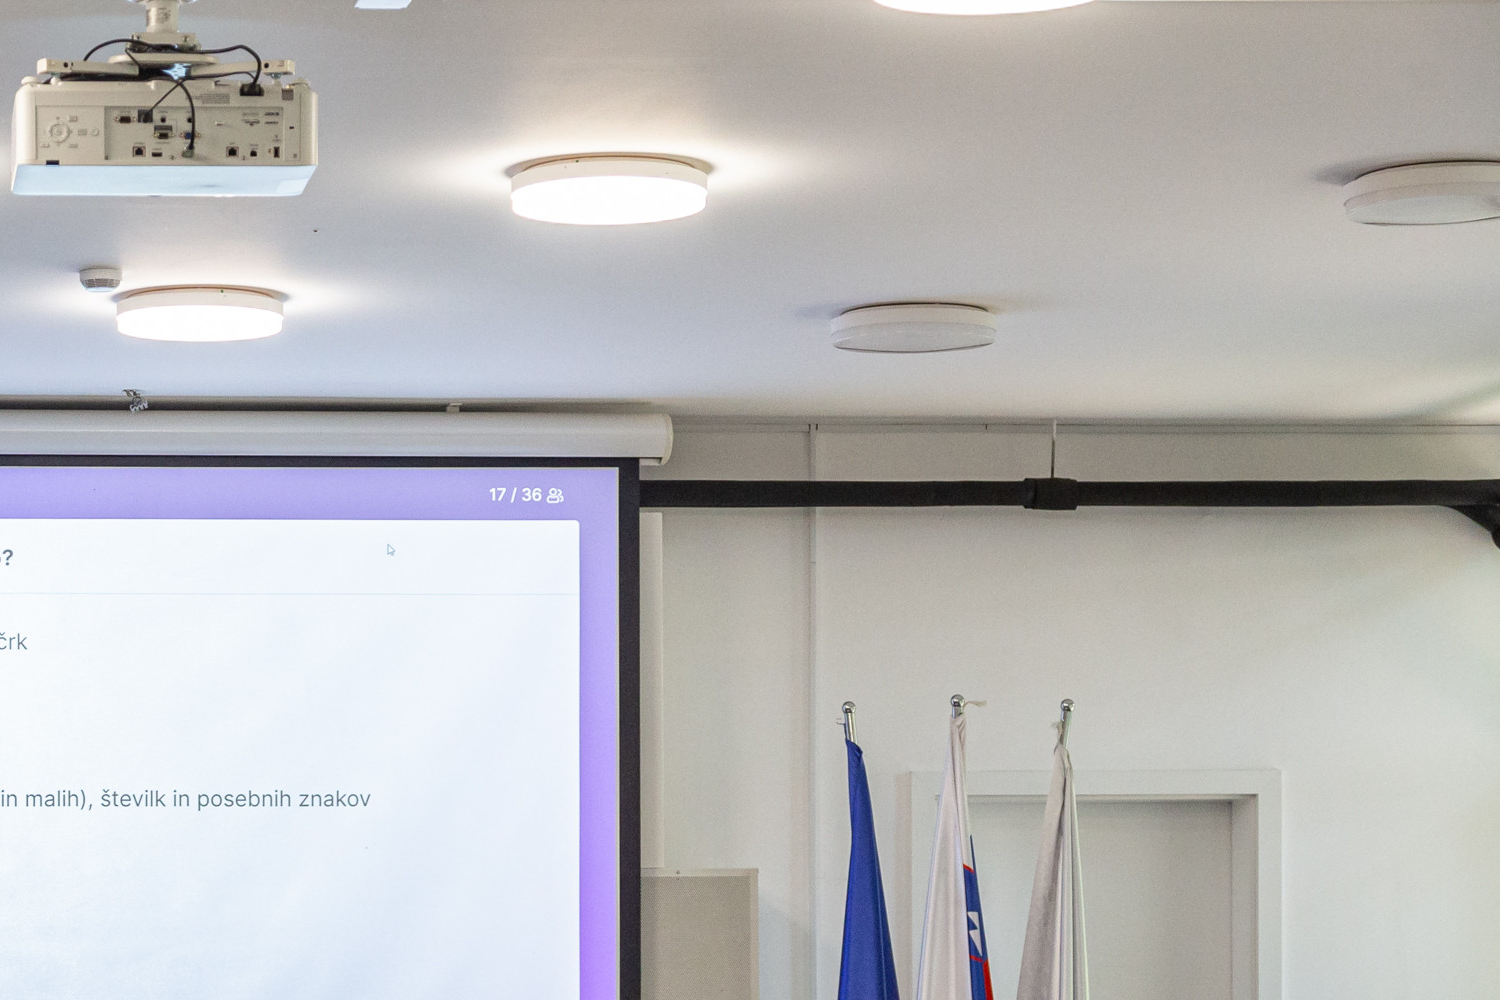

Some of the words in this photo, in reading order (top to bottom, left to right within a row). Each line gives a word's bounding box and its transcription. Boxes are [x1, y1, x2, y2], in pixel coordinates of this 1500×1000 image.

[489, 487, 507, 502] 17
[510, 486, 518, 504] /
[521, 487, 543, 502] 36
[1, 789, 18, 808] in
[25, 789, 94, 812] malih),
[100, 788, 167, 808] številk
[173, 789, 190, 808] in
[197, 789, 291, 812] posebnih
[298, 789, 371, 808] znakov
